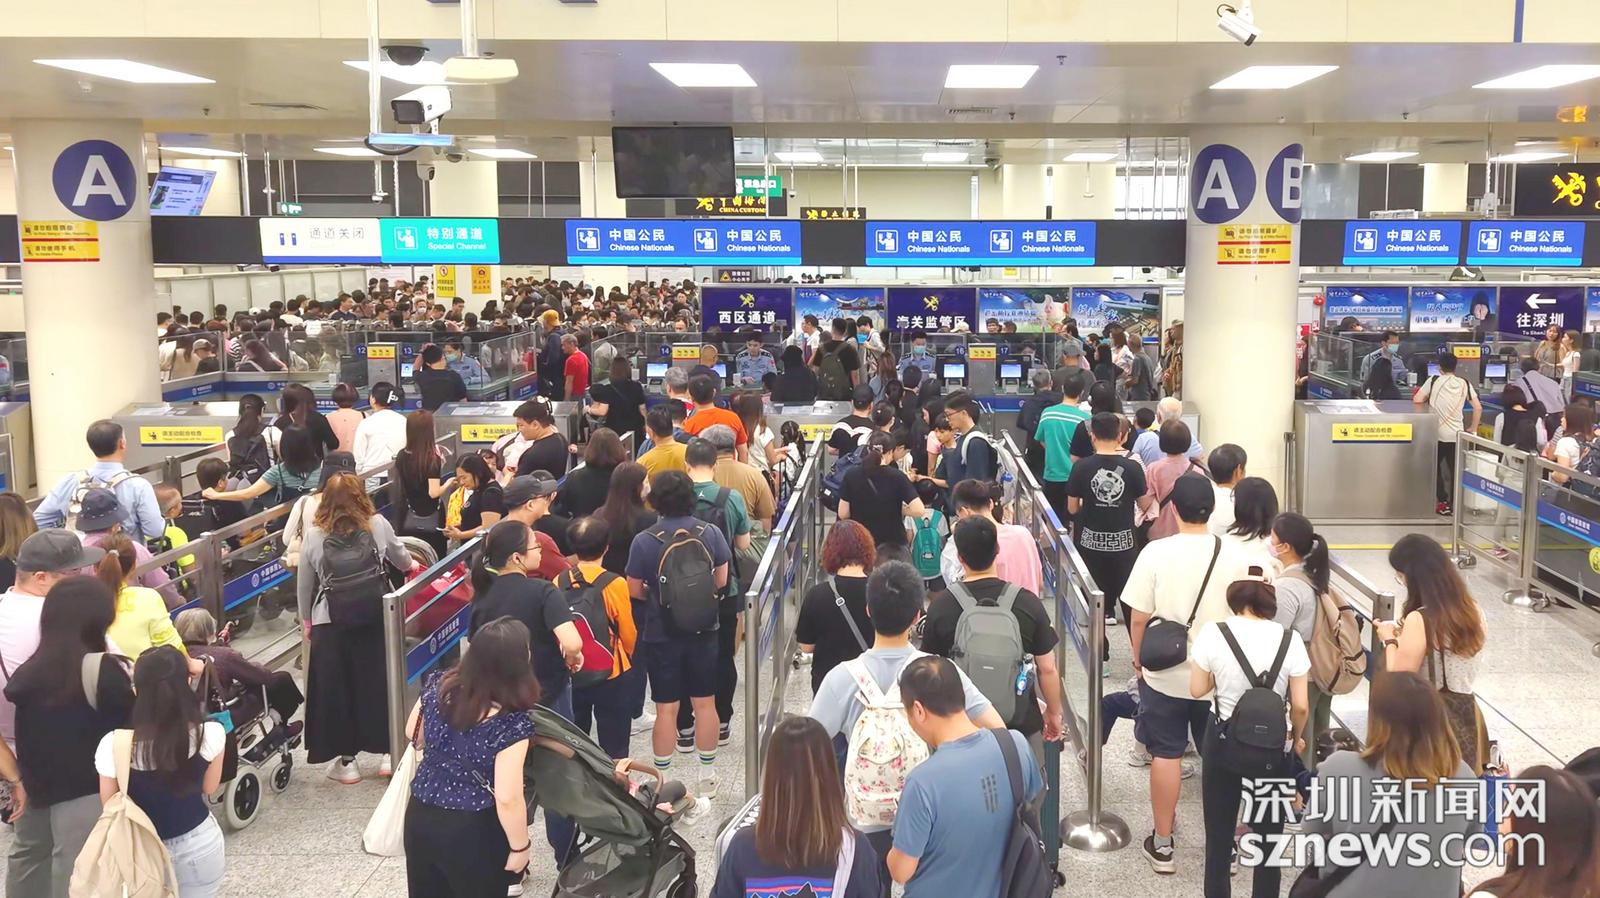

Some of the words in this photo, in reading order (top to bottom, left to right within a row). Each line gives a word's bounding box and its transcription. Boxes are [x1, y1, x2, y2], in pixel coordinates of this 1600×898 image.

[72, 154, 127, 207] A
[1196, 158, 1242, 210] A
[1282, 157, 1301, 210] B
[309, 226, 365, 240] 通道关闭
[426, 227, 484, 240] 特别通道
[609, 228, 665, 242] 中国公民
[726, 228, 782, 242] 中国公民
[907, 230, 962, 243] 中国公民
[1022, 230, 1077, 243] 中国公民
[1386, 229, 1441, 243] 中国公民
[1510, 229, 1565, 243] 中国公民
[427, 242, 455, 251] Special
[456, 242, 487, 250] Channel
[609, 243, 637, 252] Chinese
[639, 243, 675, 252] Nationals
[727, 243, 755, 252] Chinese
[757, 243, 791, 252] Nationals
[907, 244, 936, 253] Chinese
[937, 244, 970, 253] Nationals
[1021, 244, 1050, 253] Chinese
[1051, 244, 1085, 253] Nationals
[1386, 243, 1414, 252] Chinese
[1415, 243, 1449, 252] Nationals
[1509, 243, 1537, 253] Chinese
[1539, 243, 1573, 253] Nationals
[718, 310, 776, 324] 西区通道
[896, 315, 967, 329] 海关监管区
[1516, 312, 1565, 328] 往深圳
[403, 347, 412, 355] 13
[661, 347, 670, 355] 14
[1000, 347, 1008, 355] 17
